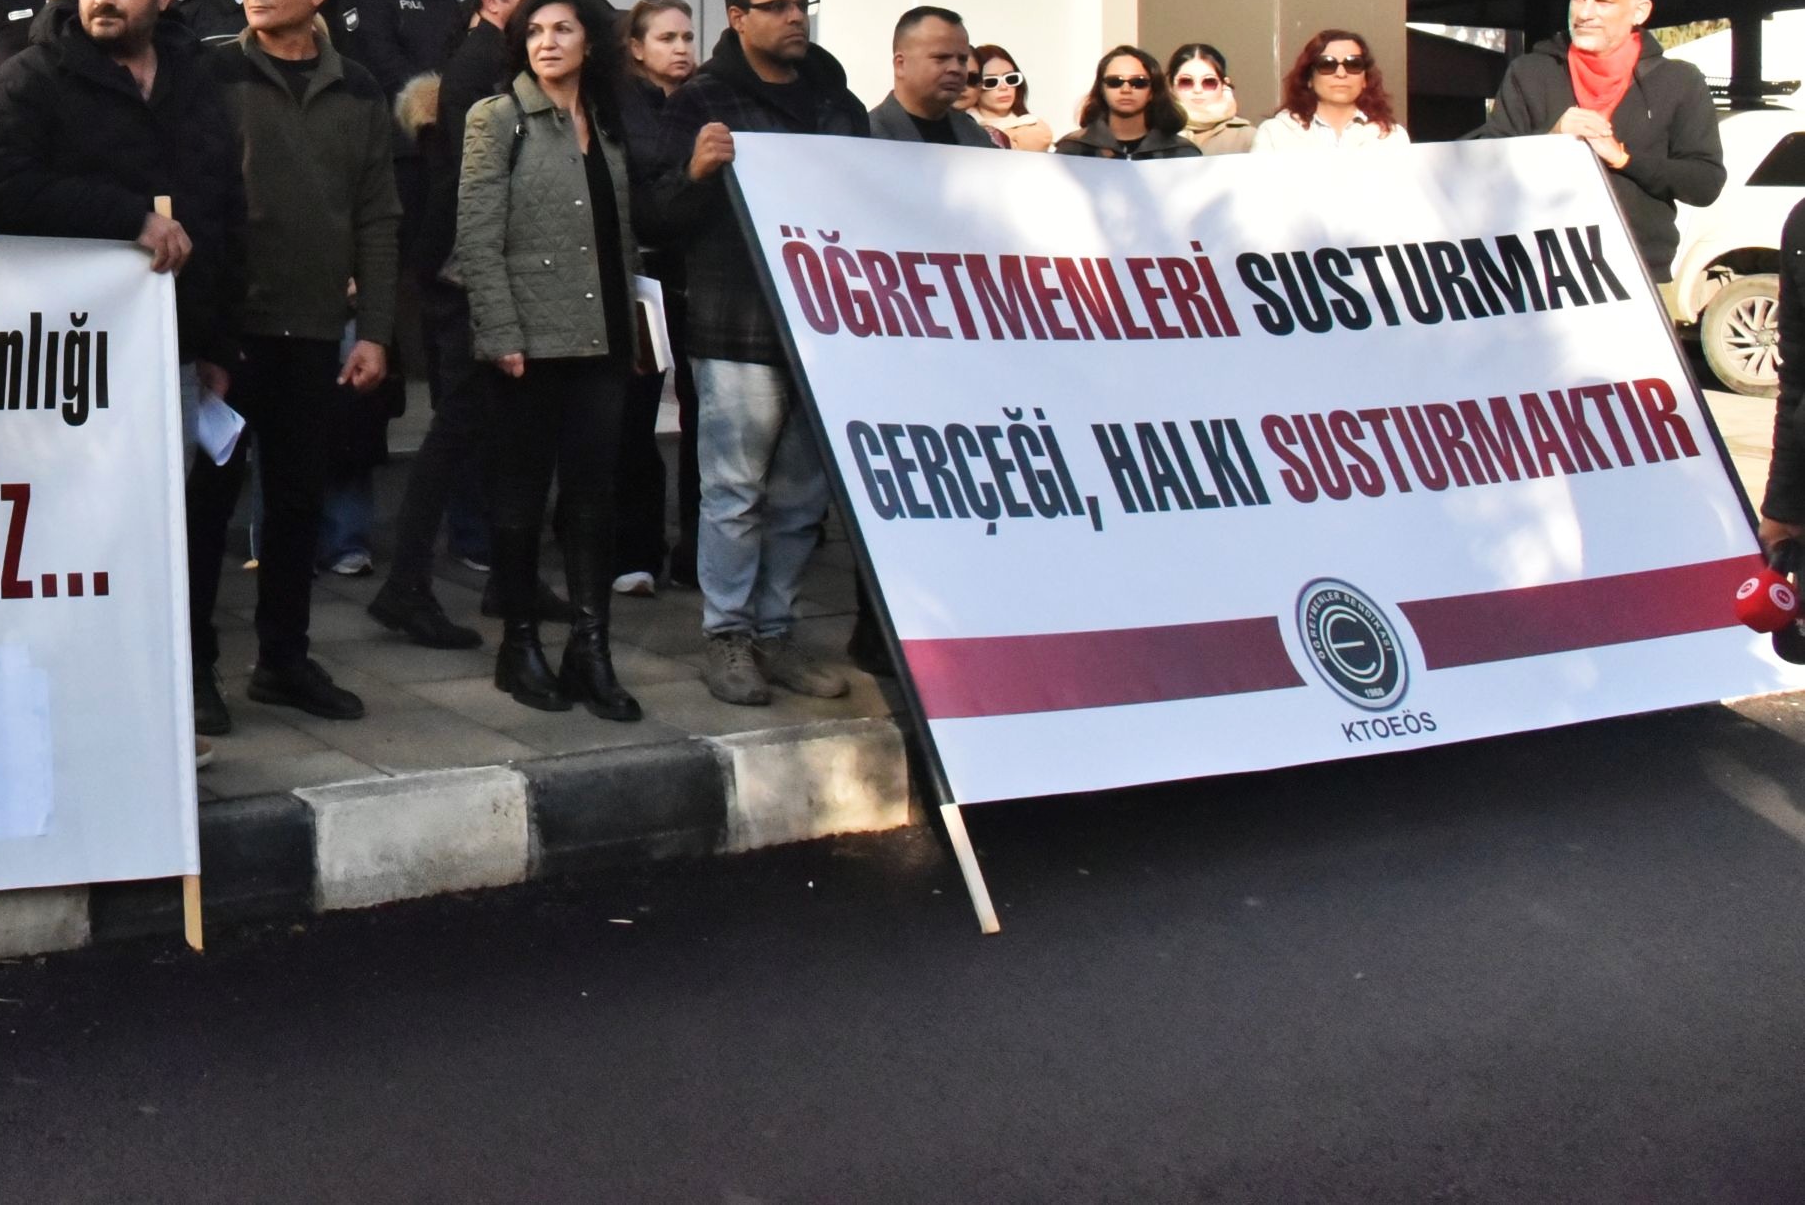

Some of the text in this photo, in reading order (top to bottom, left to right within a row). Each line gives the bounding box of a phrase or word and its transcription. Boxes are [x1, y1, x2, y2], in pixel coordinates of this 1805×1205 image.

[780, 225, 1631, 340] ÖĞRETMENLERİ SUSTURMAK
[846, 378, 1701, 536] GERÇEĞİ, HALKI SUSTURMAKTIR
[1341, 709, 1437, 743] KTOEÖS
